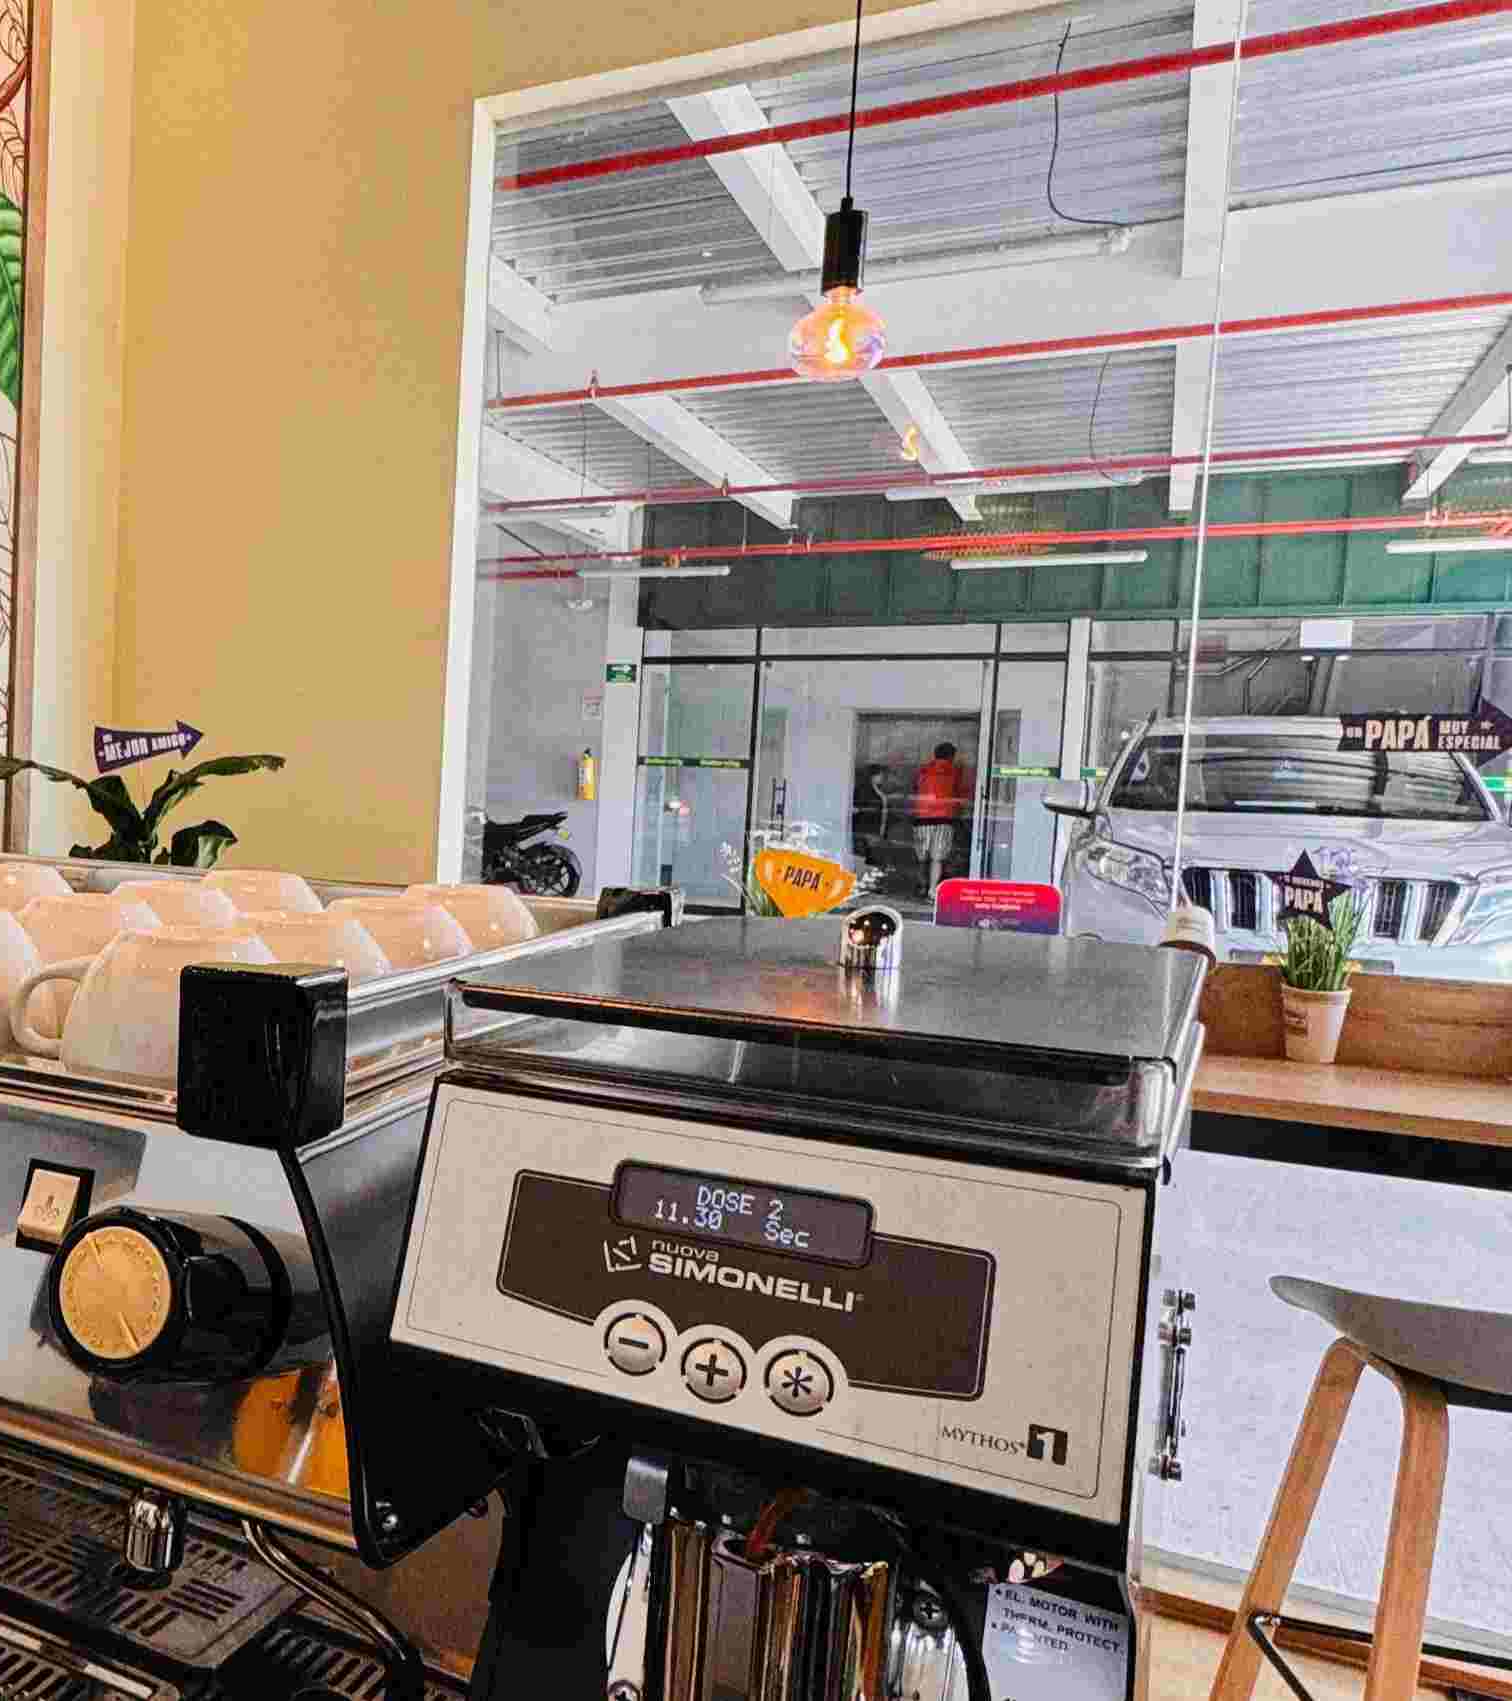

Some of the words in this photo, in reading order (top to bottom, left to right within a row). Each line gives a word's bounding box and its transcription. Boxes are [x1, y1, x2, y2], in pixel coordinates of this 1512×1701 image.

[104, 737, 149, 762] MEJOR
[151, 733, 186, 751] AMIGO
[1364, 715, 1431, 750] PAPÁ
[1439, 720, 1469, 734] MUY
[1438, 735, 1501, 750] ESPECIAL
[697, 1185, 755, 1215] DOSE
[768, 1200, 783, 1221] 2
[654, 1199, 722, 1230] 11.30
[764, 1220, 810, 1248] Sec
[652, 1239, 719, 1262] nuova
[648, 1254, 855, 1312] SIMONELLI
[1030, 1597, 1078, 1619] MOTOR
[1085, 1615, 1119, 1632] WITH
